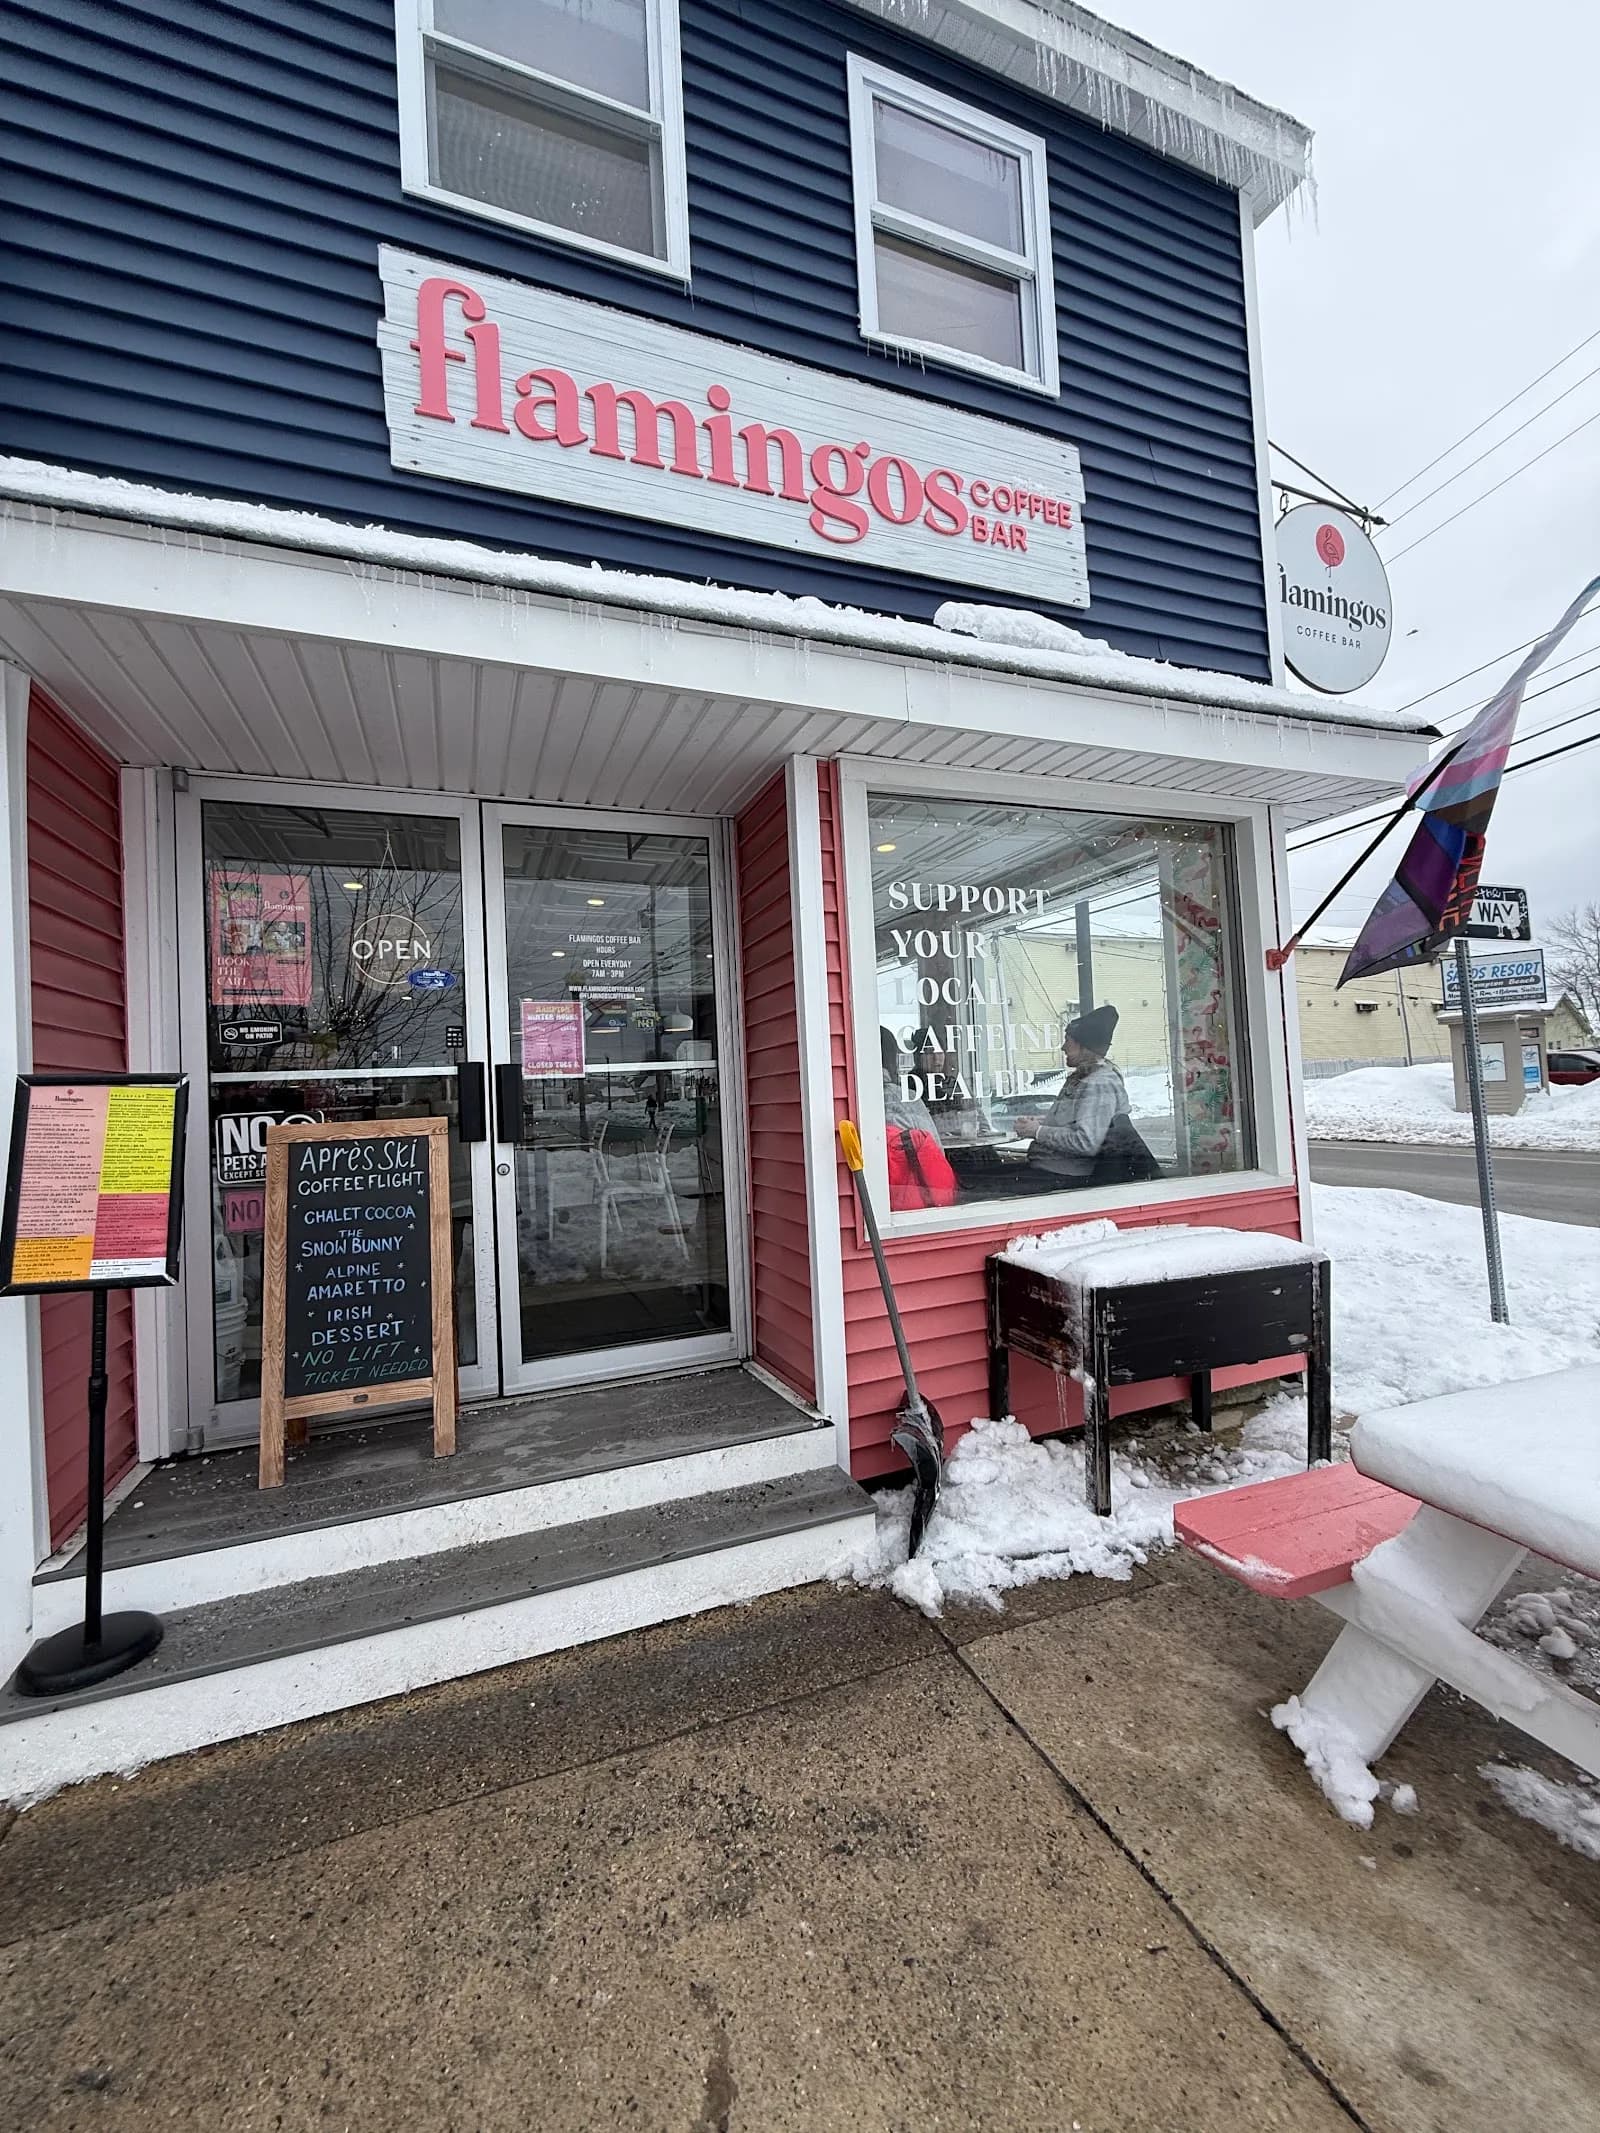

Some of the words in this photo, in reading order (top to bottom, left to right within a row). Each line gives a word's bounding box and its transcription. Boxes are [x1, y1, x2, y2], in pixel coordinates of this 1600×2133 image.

[409, 277, 969, 544] flamingos
[969, 479, 1073, 529] COFFEE
[971, 512, 1028, 552] BAR
[1297, 625, 1337, 643] COFFEE
[1342, 636, 1362, 649] BAR
[888, 881, 1051, 915] SUPPORT
[1477, 902, 1513, 923] WAY
[352, 939, 431, 960] OPEN
[568, 934, 604, 944] FLAMINGOS
[605, 935, 628, 944] COFFEE
[628, 935, 642, 944] BAR
[596, 946, 616, 954] HOURS
[890, 929, 988, 959] YOUR
[217, 957, 250, 966] BOOK
[218, 967, 241, 976] THE
[582, 959, 600, 968] OPEN
[600, 960, 632, 968] EVERYDAY
[1446, 966, 1487, 983] SADS
[1491, 961, 1541, 978] RESORT
[591, 969, 606, 977] 7AM
[610, 969, 625, 978] 3PM
[895, 976, 1009, 1006] LOCAL
[896, 1023, 1063, 1054] CAFFEINE
[899, 1069, 1036, 1103] DEALER
[221, 1115, 277, 1155] NO
[223, 1154, 257, 1171] PETS
[223, 1170, 253, 1180] EXCEPT
[298, 1175, 364, 1196] COFFEE
[368, 1171, 424, 1189] FLIGHT
[229, 1199, 261, 1221] NO
[304, 1207, 362, 1225] CHALET
[364, 1205, 416, 1220] COCOA
[338, 1229, 364, 1238] THE
[301, 1237, 347, 1257] SNOW
[351, 1236, 404, 1254] BUNNY
[326, 1263, 381, 1278] ALPINE
[307, 1278, 406, 1301] AMARETTO
[327, 1306, 372, 1322] IRISH
[311, 1321, 404, 1346] DESSERT
[302, 1350, 334, 1368] NO
[348, 1341, 405, 1362] LIFT
[303, 1366, 365, 1387] TICKET
[369, 1358, 429, 1379] NEEDED
